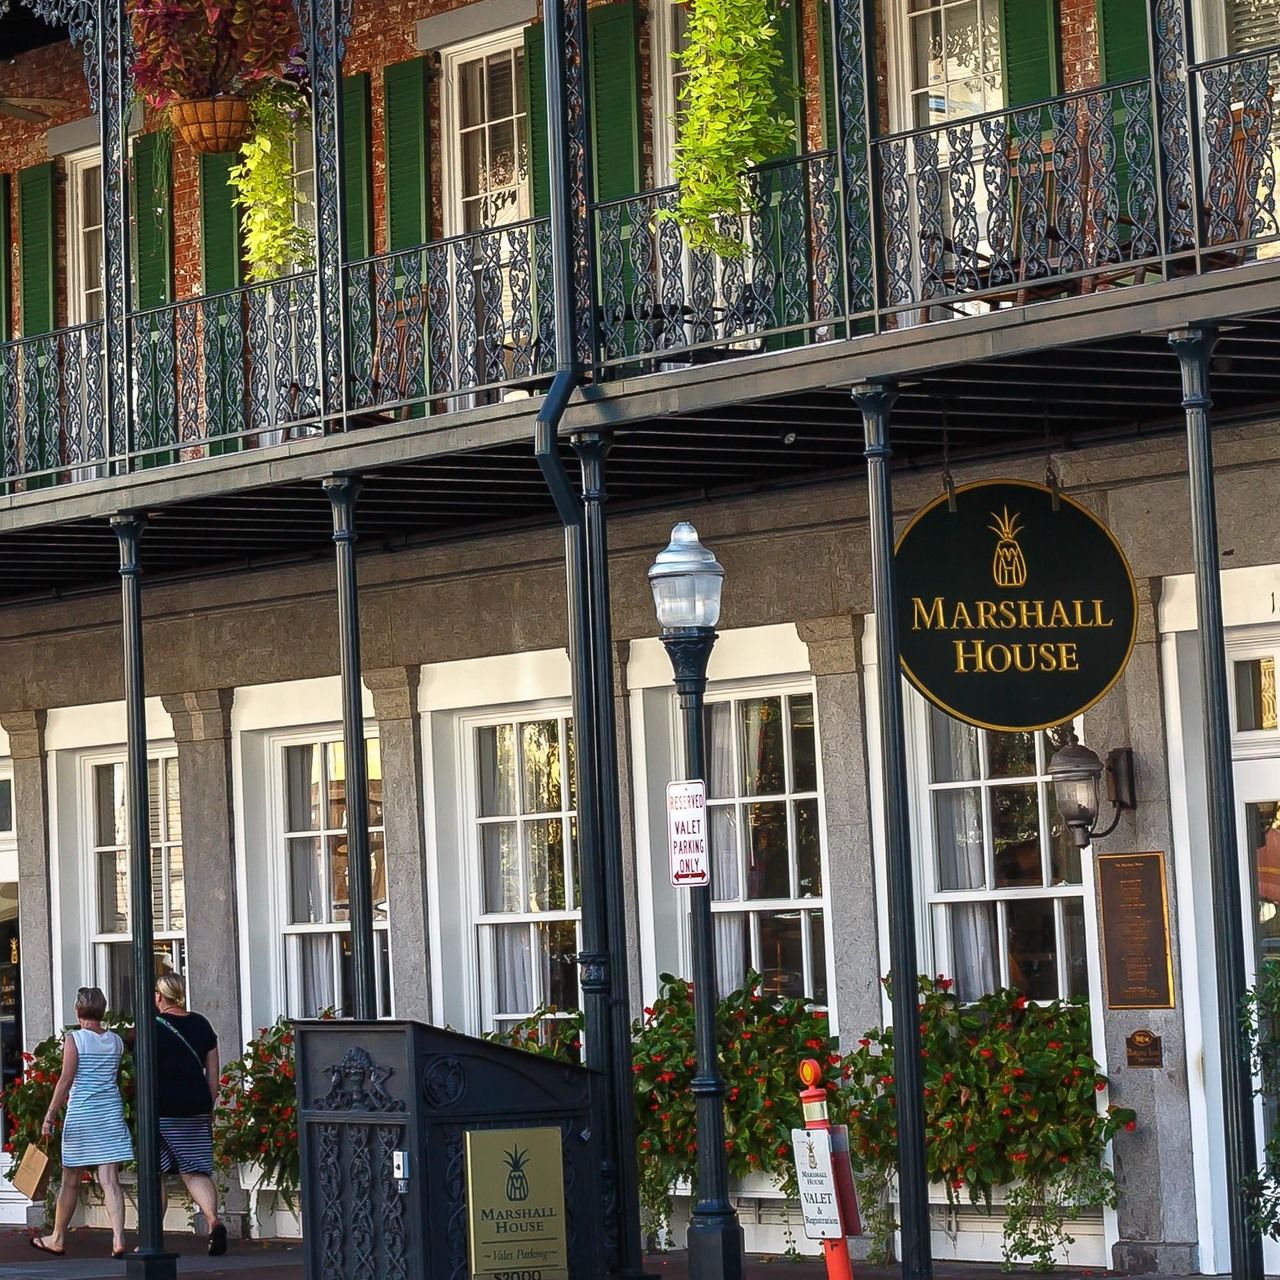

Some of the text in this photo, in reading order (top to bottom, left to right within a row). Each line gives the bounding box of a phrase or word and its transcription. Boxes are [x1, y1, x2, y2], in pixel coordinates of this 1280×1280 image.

[911, 596, 1114, 630] MARSHALL
[952, 639, 1079, 673] HOUSE
[670, 794, 704, 810] RESERVED
[675, 820, 701, 835] VALET
[673, 839, 704, 855] PARKING
[679, 858, 700, 873] ONLY
[803, 1192, 832, 1204] VALET
[481, 1207, 557, 1221] MARSHALL
[816, 1207, 823, 1215] &
[496, 1221, 544, 1234] HOUSE
[805, 1215, 838, 1226] Registration
